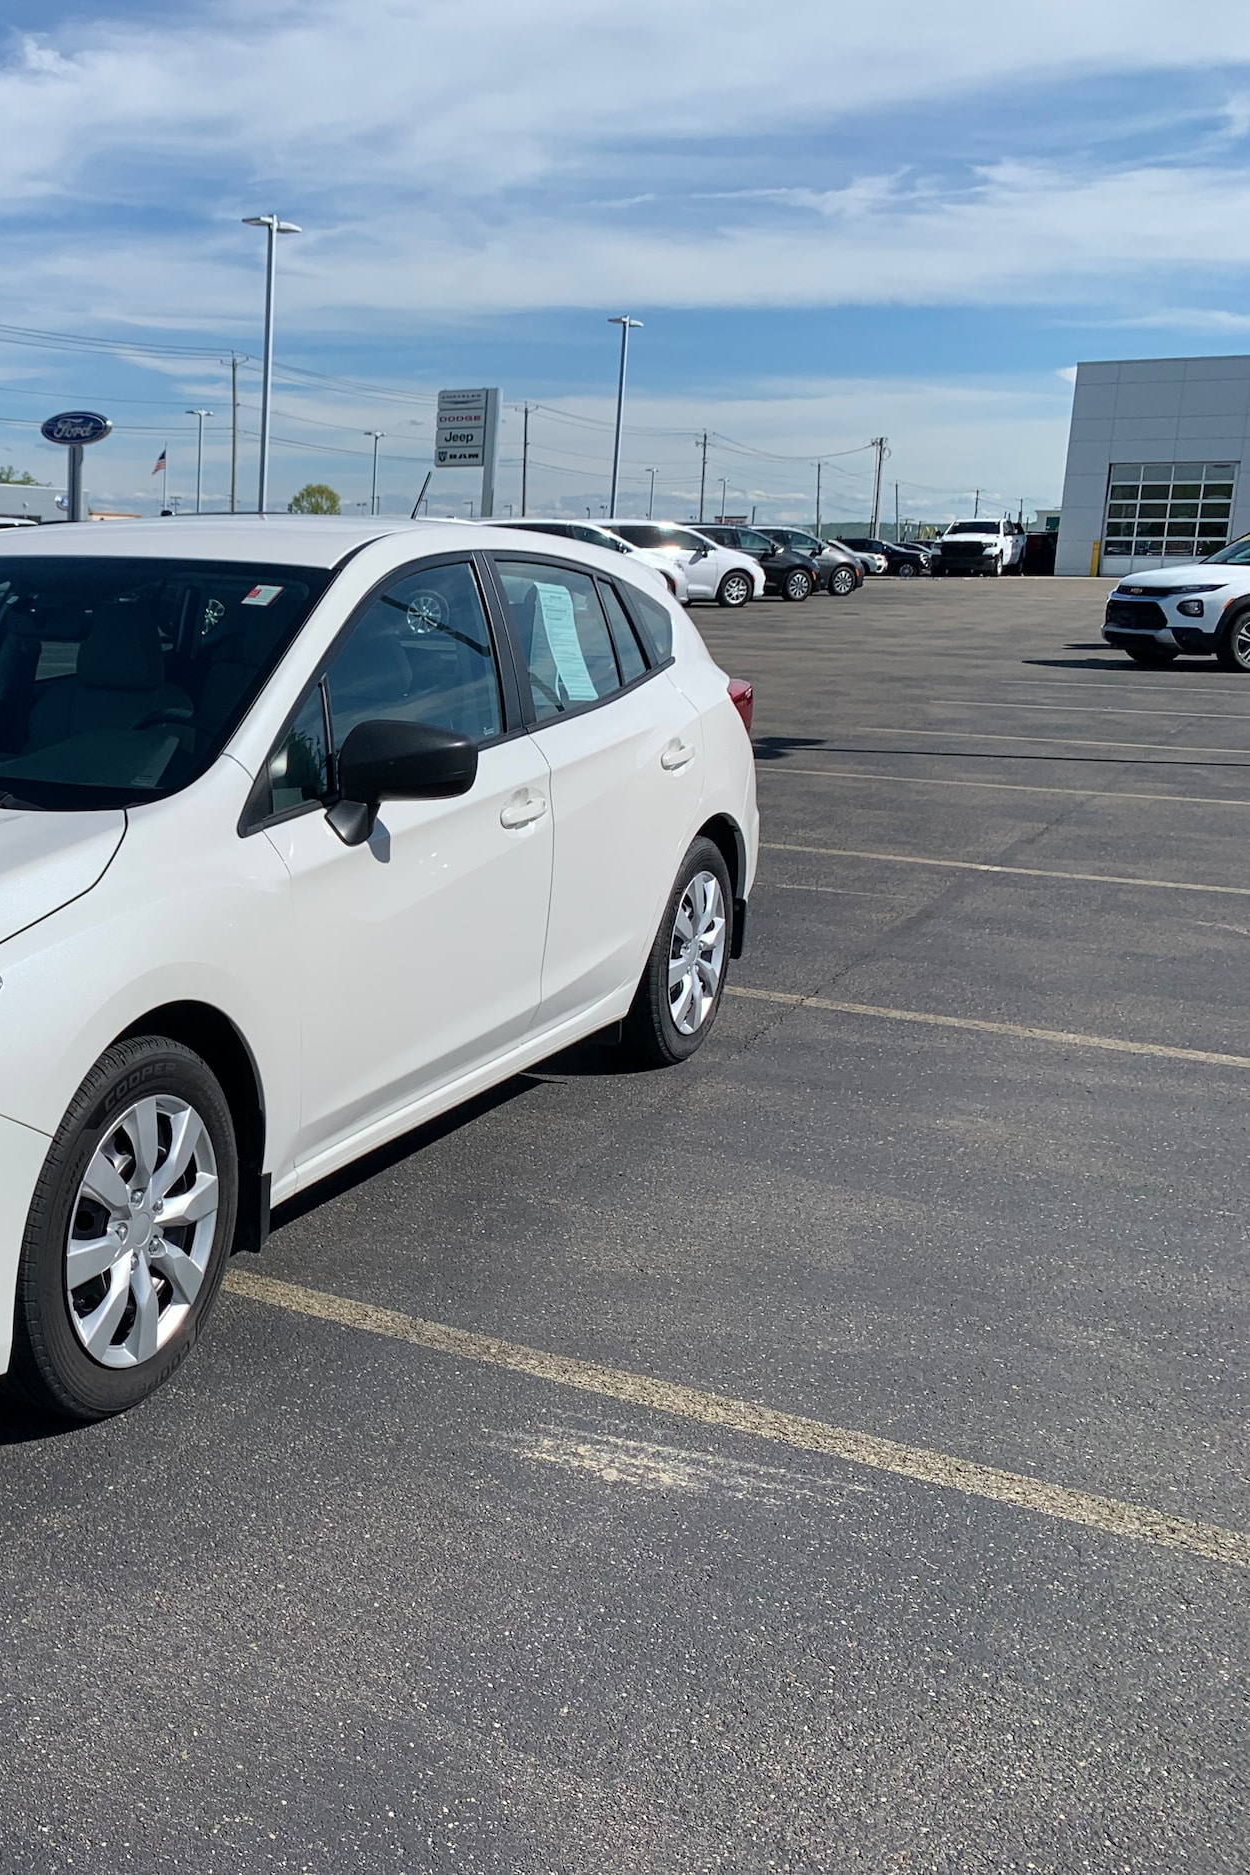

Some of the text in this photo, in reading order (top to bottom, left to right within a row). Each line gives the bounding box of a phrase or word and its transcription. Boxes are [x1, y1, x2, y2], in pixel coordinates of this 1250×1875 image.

[439, 415, 481, 423] DODGE
[53, 418, 94, 438] Ford
[444, 431, 475, 444] Jeep
[104, 1062, 177, 1112] COOPER
